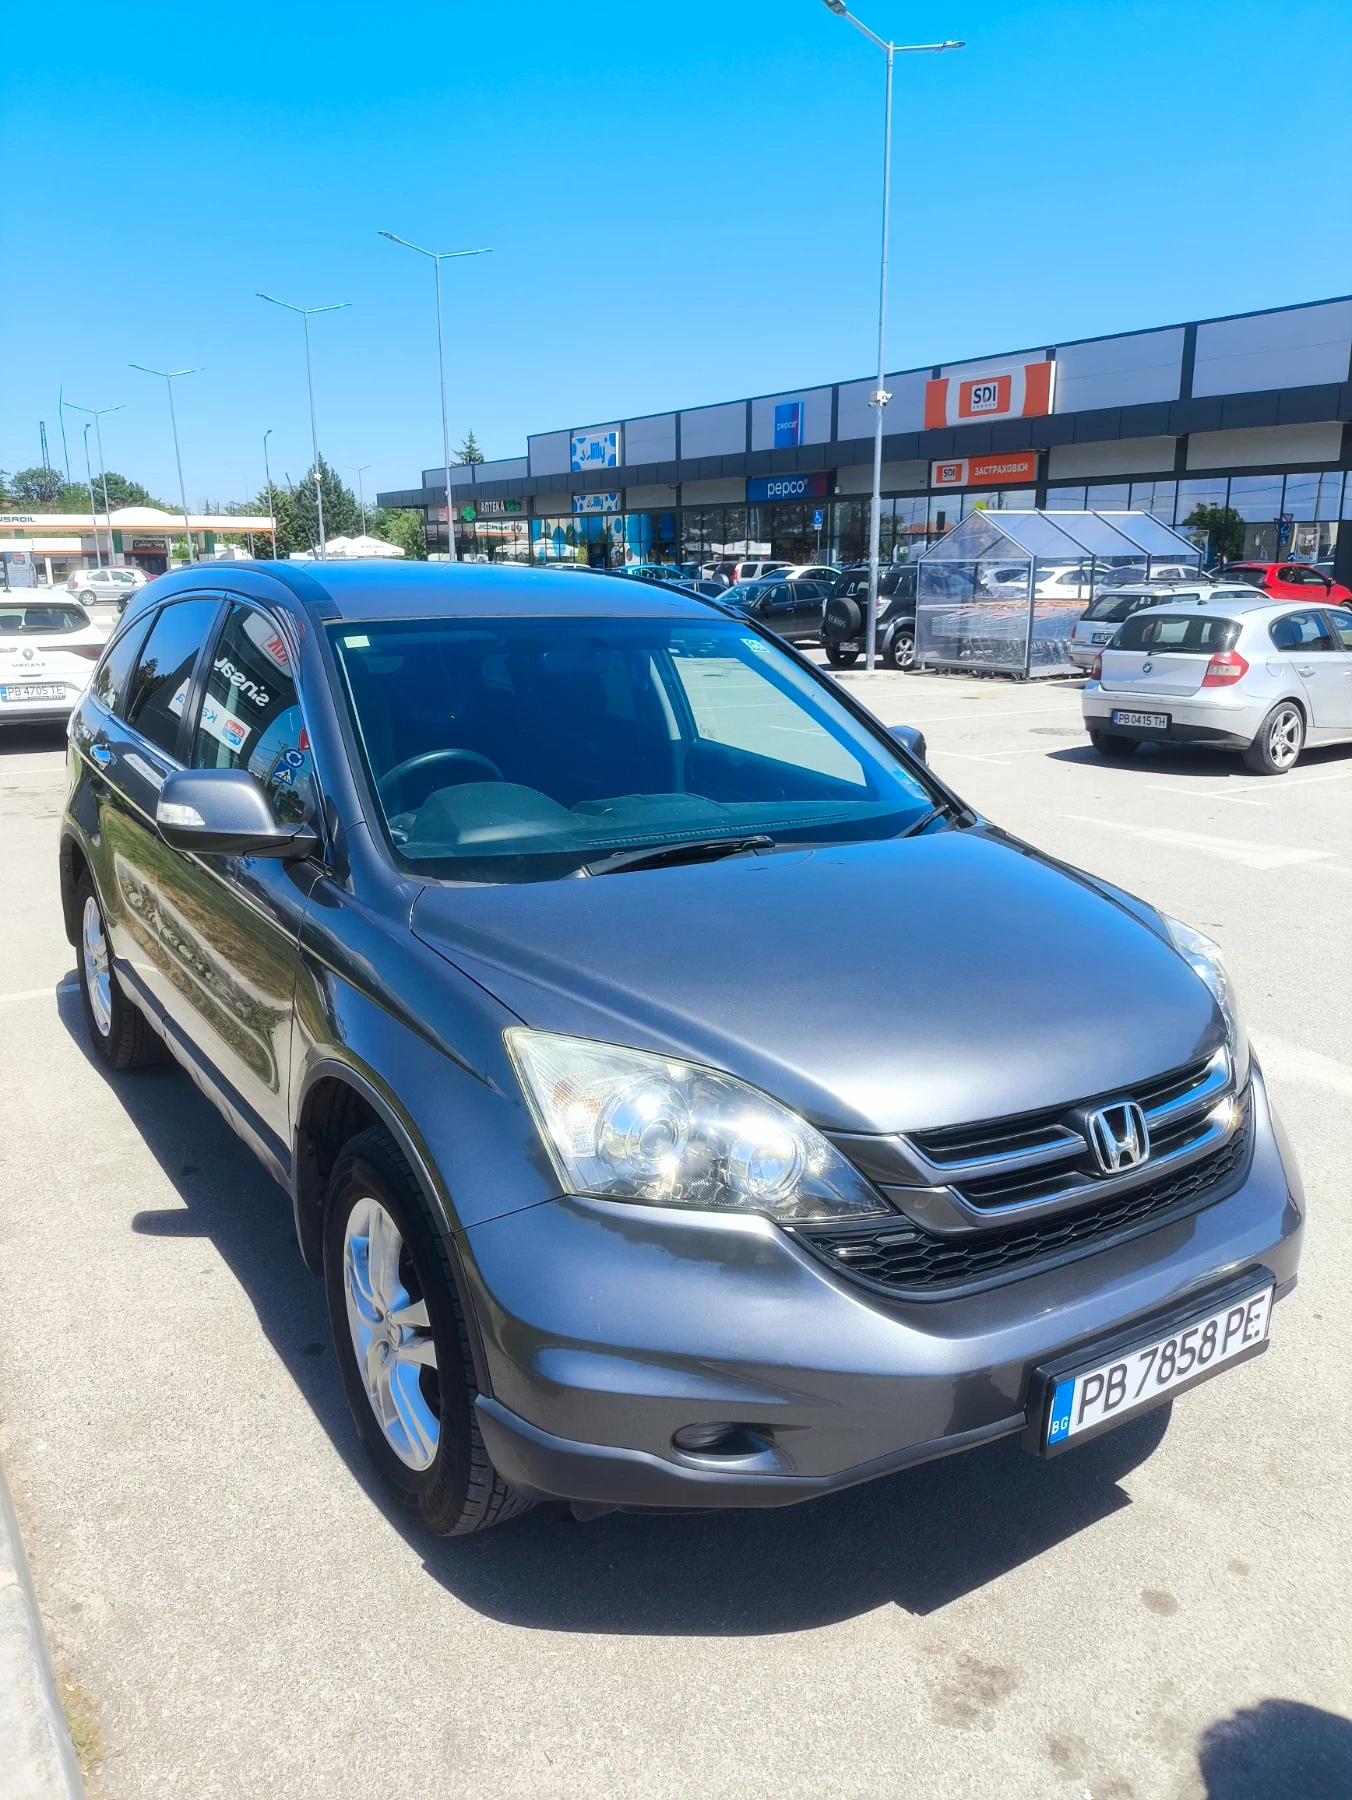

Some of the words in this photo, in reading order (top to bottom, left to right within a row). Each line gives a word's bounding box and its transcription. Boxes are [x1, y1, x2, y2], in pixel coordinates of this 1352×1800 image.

[973, 386, 996, 404] SDI
[777, 421, 796, 431] pepco
[591, 442, 605, 464] lilly
[943, 468, 955, 478] SDI
[974, 463, 1028, 476] ЗАСТРАХОВКИ
[768, 481, 804, 498] pepco
[481, 500, 505, 513] АПТЕКА
[153, 541, 165, 549] Shop
[828, 614, 846, 628] TERIOS
[50, 685, 64, 695] TE
[1119, 714, 1130, 724] PB
[1132, 715, 1152, 726] 0415
[1154, 717, 1166, 727] TH
[1076, 1363, 1128, 1426] PB
[1133, 1319, 1217, 1400] 7858
[1220, 1295, 1266, 1356] PE
[1051, 1415, 1069, 1435] BG
